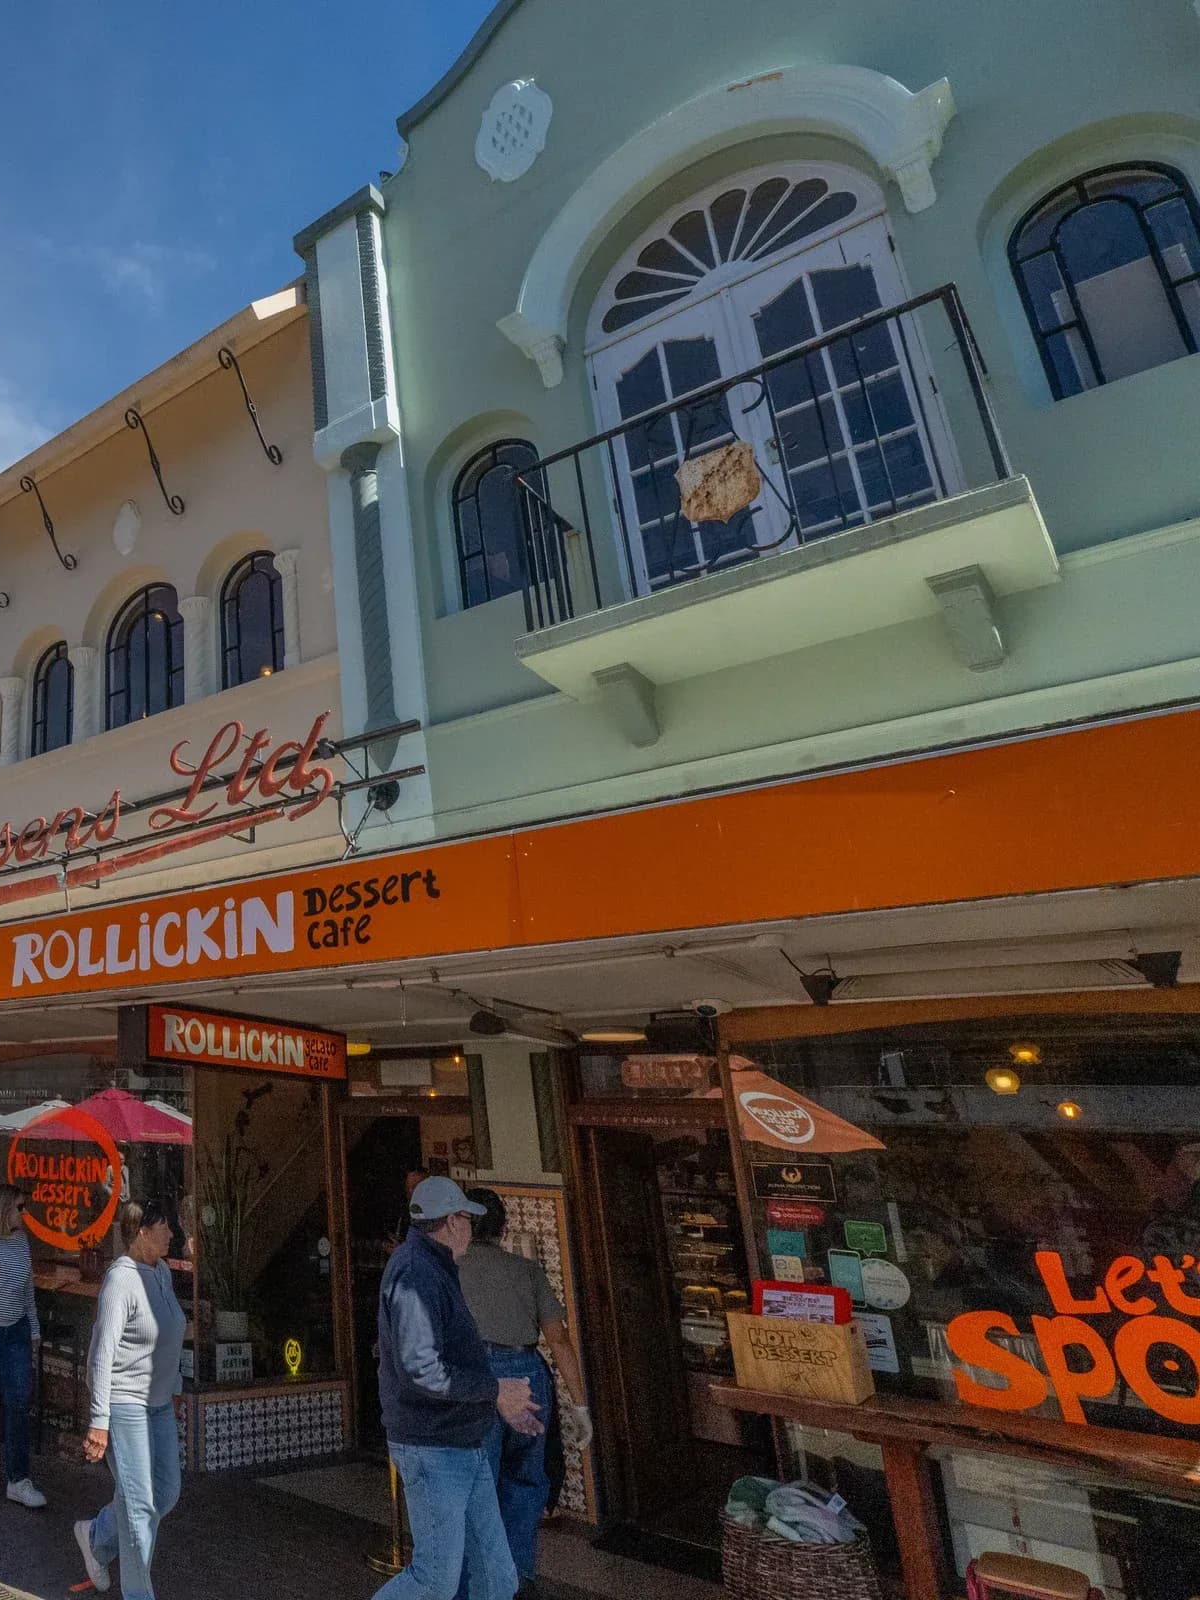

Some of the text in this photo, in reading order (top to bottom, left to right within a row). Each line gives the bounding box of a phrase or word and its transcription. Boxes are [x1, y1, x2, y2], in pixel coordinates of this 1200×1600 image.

[148, 709, 334, 829] Ltd
[303, 869, 440, 917] Dessert
[307, 914, 371, 950] cafe
[31, 1182, 91, 1208] dessert
[46, 1205, 79, 1230] cafe
[1035, 1250, 1200, 1317] Let'
[749, 1327, 796, 1348] HOT
[751, 1345, 838, 1368] DESSERT
